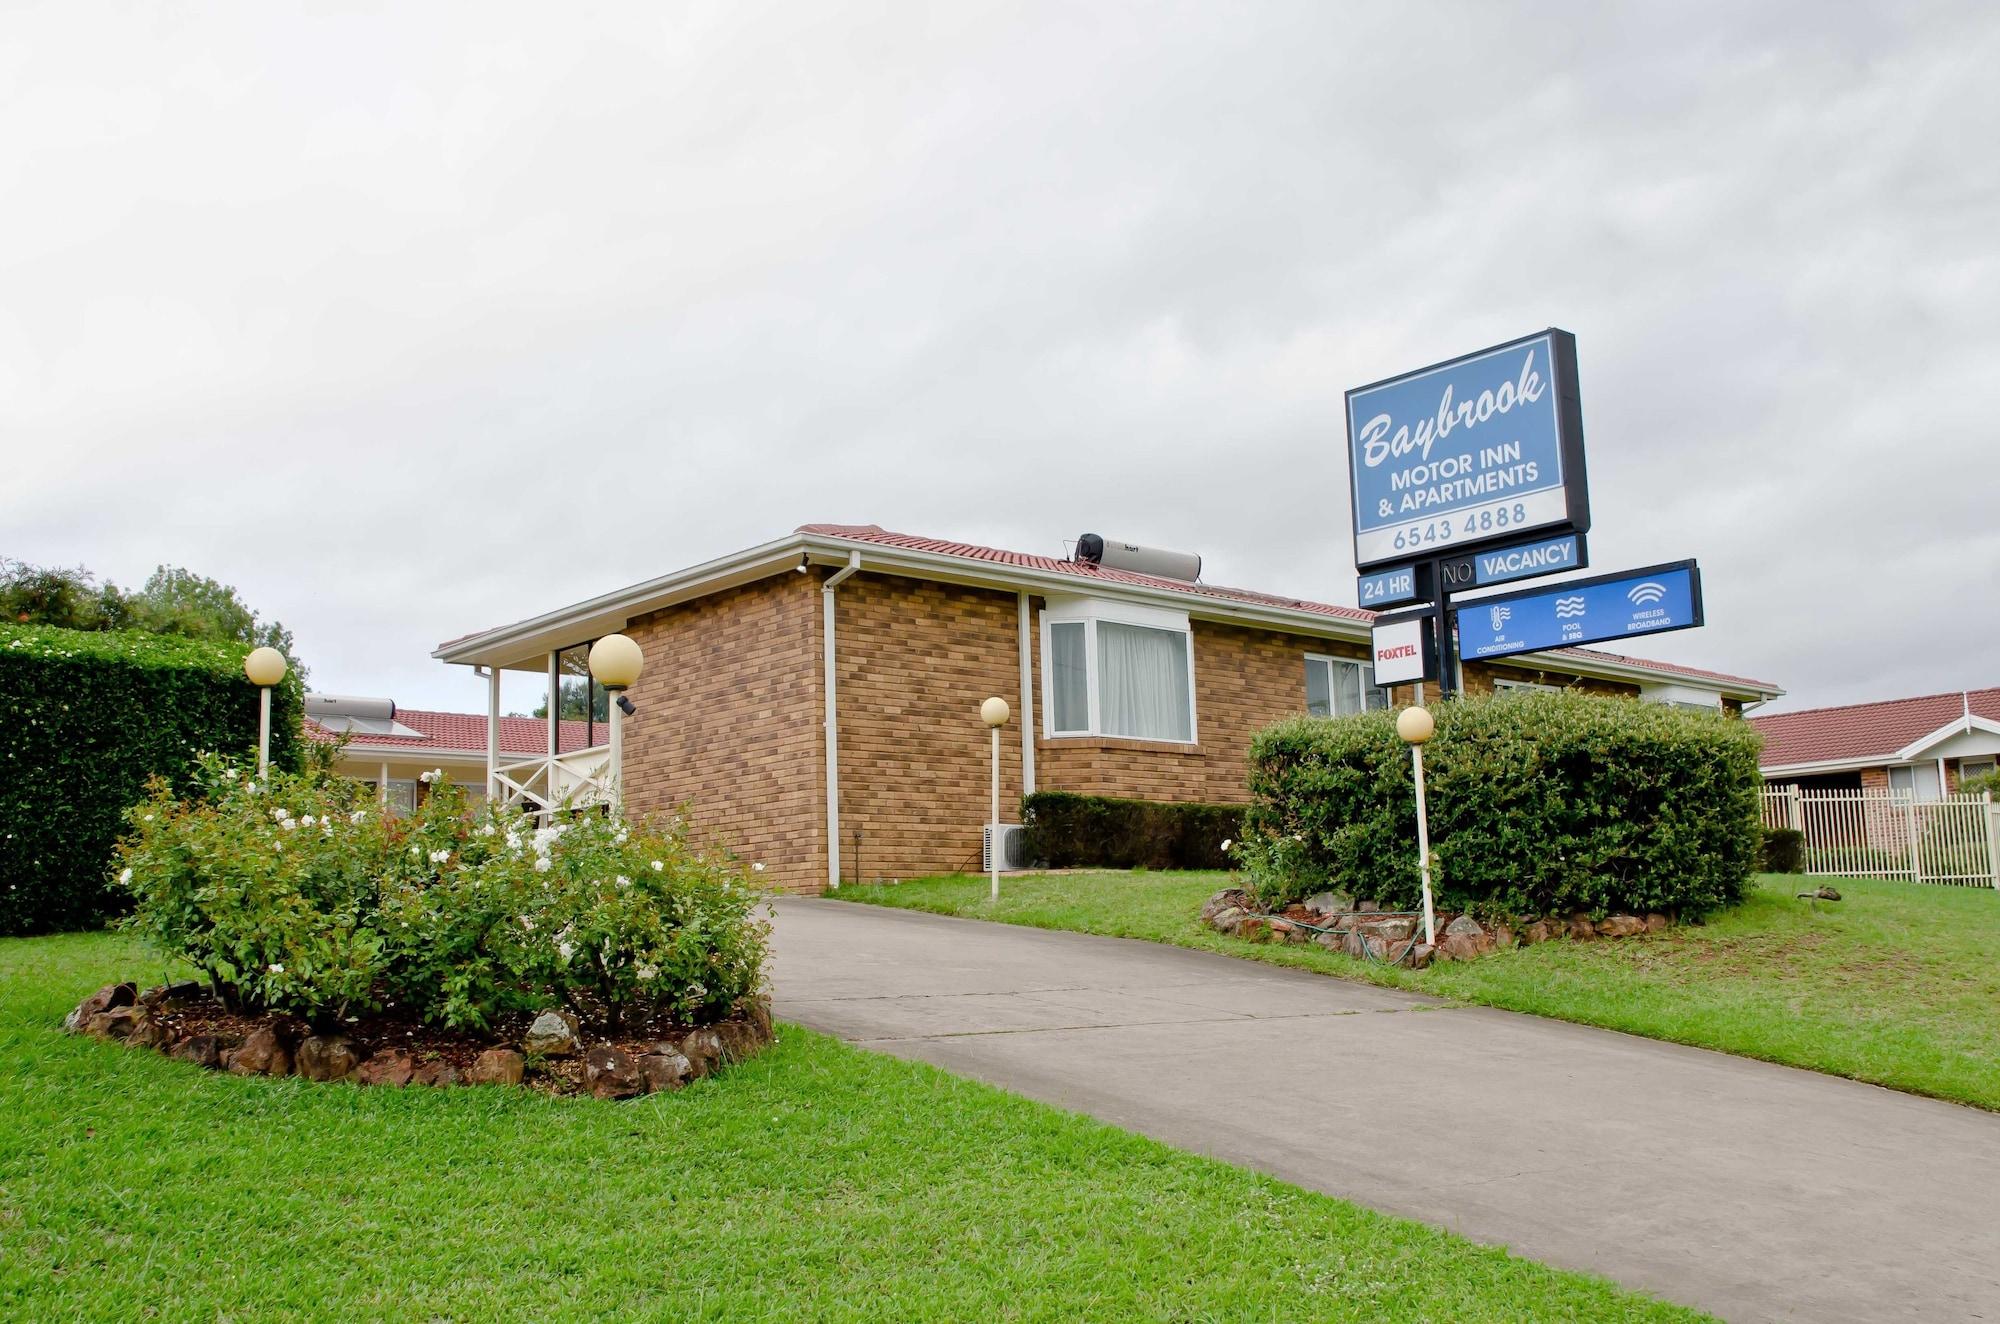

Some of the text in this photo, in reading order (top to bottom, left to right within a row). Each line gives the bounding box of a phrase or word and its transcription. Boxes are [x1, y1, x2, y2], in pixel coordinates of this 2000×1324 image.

[1359, 349, 1547, 468] Baybrook
[1391, 441, 1521, 491] MOTOR INN
[1378, 462, 1539, 518] & APARTMENTS
[1393, 503, 1526, 550] 6543 4888
[1443, 543, 1571, 584] NO VACANCY
[1364, 575, 1410, 599] 24 HR
[1627, 617, 1671, 631] BROADBAND
[1632, 608, 1665, 621] WIRELESS
[1562, 623, 1581, 632] POOL
[1377, 644, 1417, 662] FOXTEL
[1476, 642, 1525, 655] CONDITIONING
